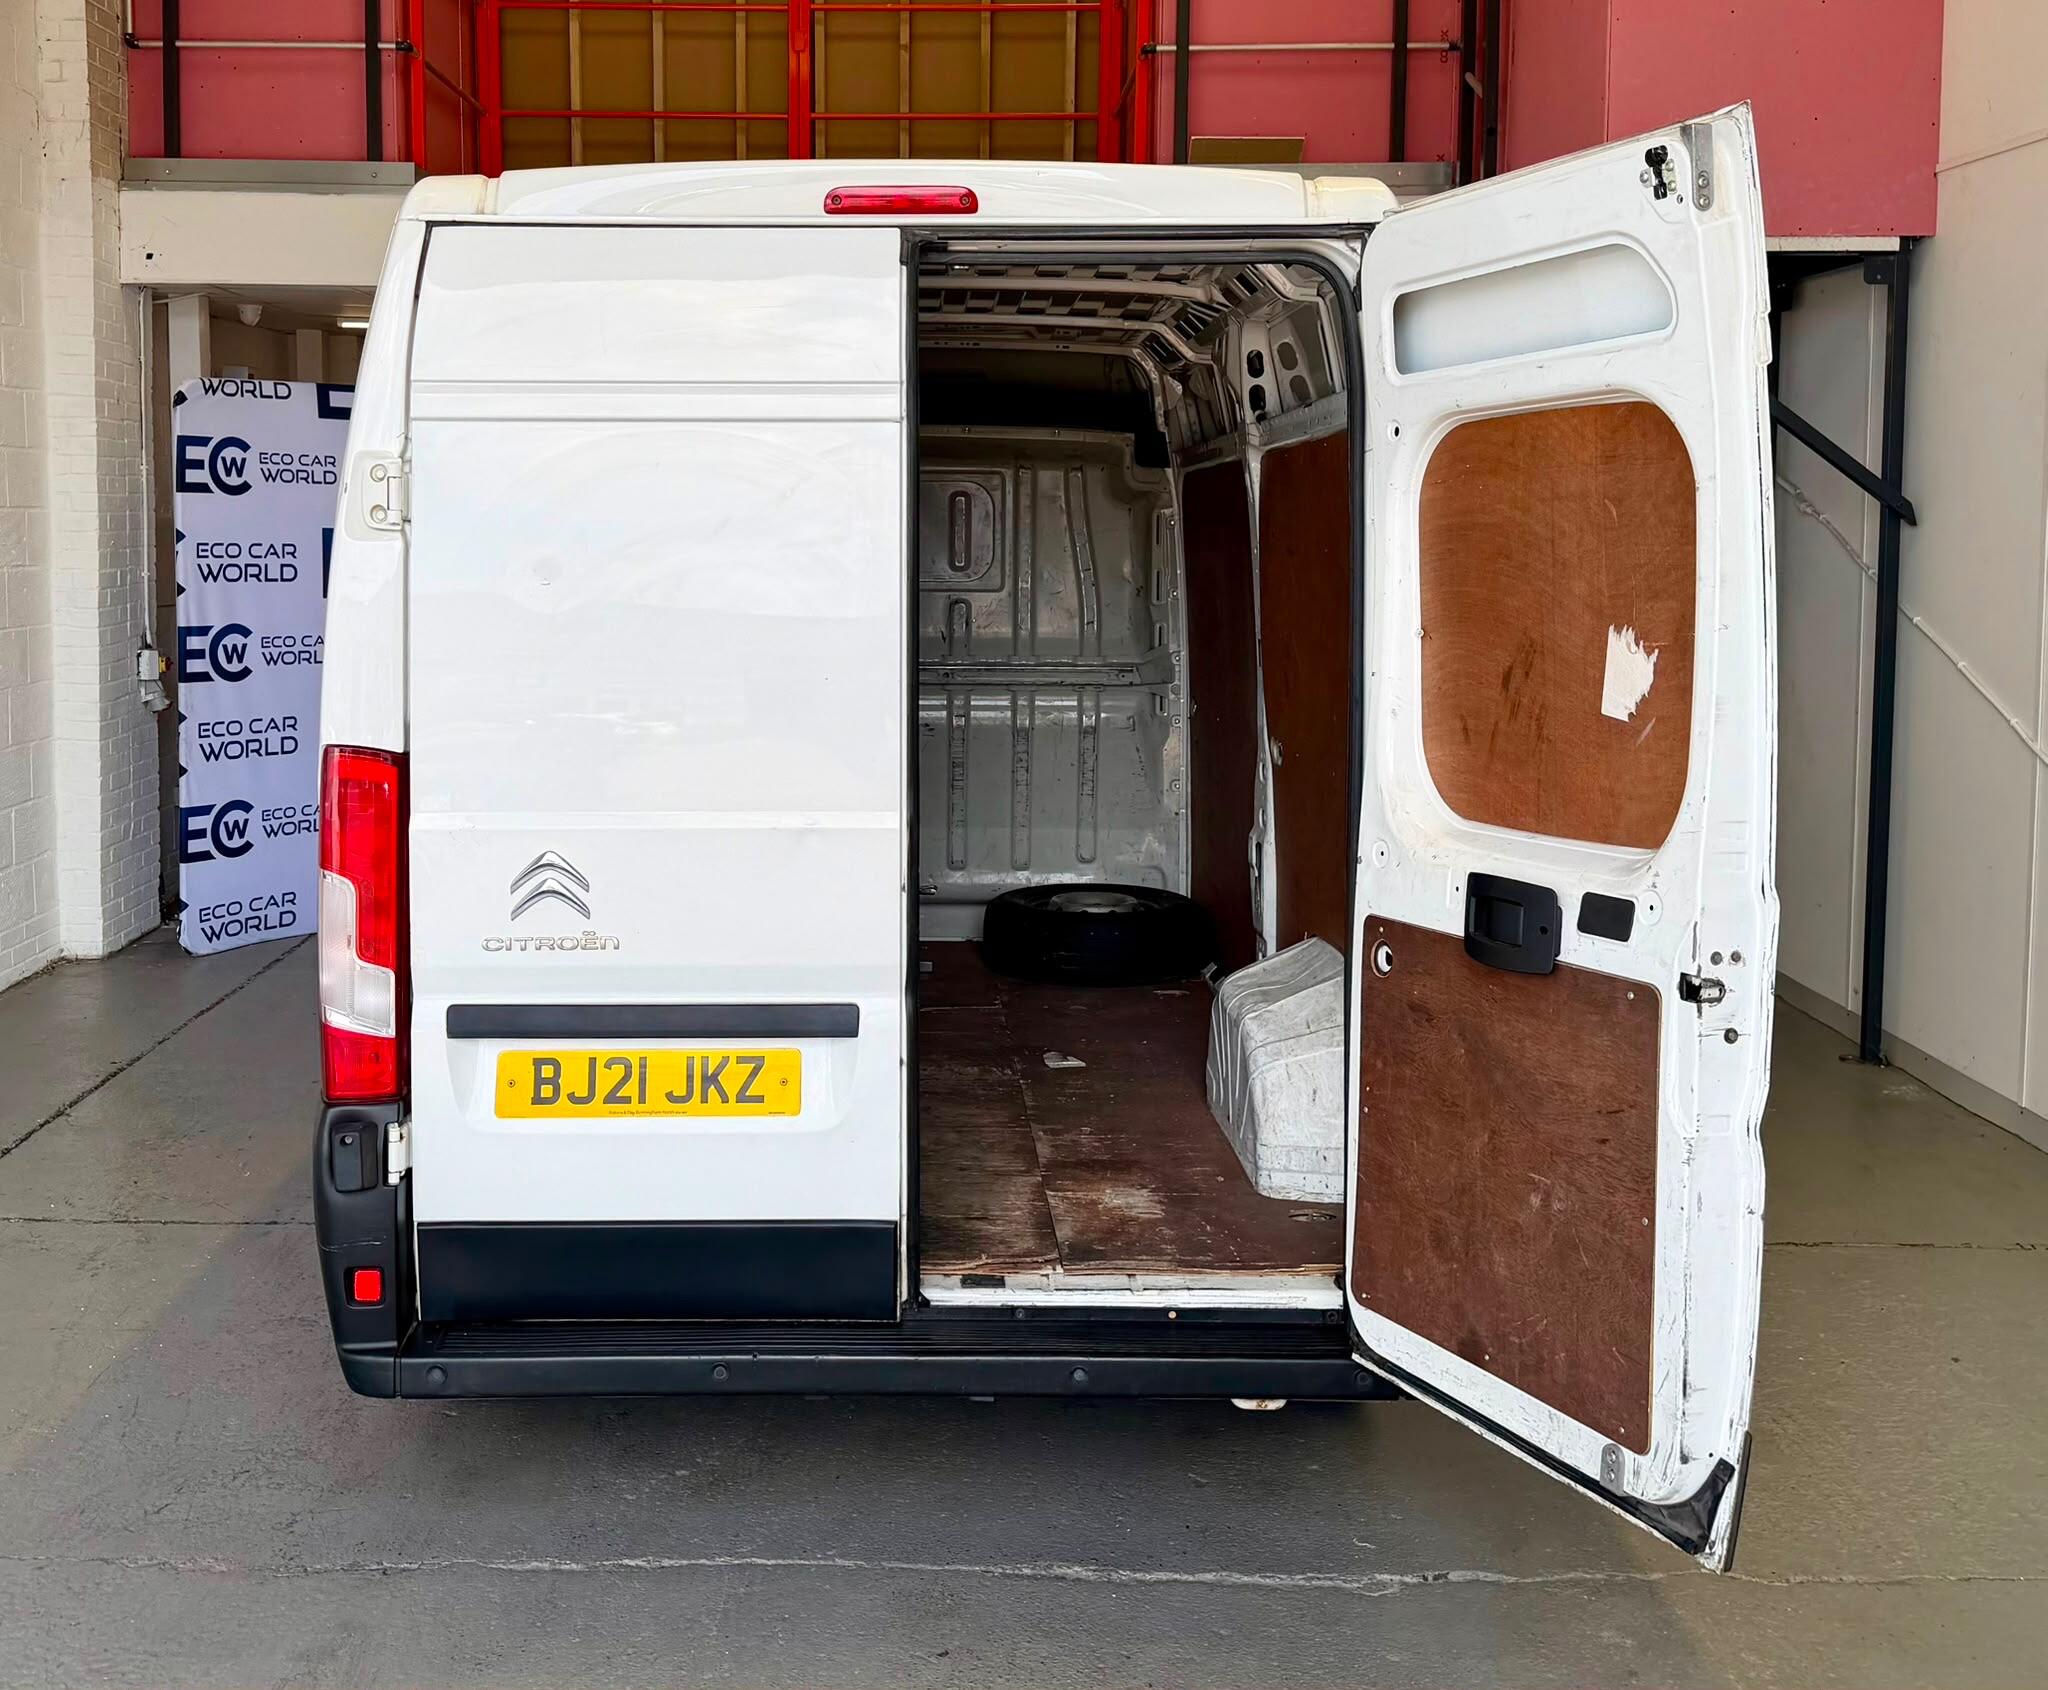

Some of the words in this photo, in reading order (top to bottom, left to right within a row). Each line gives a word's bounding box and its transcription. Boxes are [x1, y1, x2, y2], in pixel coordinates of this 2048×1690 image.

[200, 377, 292, 400] WORLD
[259, 452, 294, 465] ECO
[298, 454, 337, 467] CAR
[260, 467, 338, 485] WORLD
[196, 542, 242, 559] ECO
[248, 543, 298, 559] CAR
[197, 563, 298, 583] WORLD
[261, 636, 297, 648] ECO
[301, 635, 325, 647] CA
[261, 650, 324, 666] WORL
[198, 720, 243, 739] ECO
[249, 716, 298, 735] CAR
[199, 736, 299, 763] WORLD
[262, 806, 297, 822] ECO
[262, 818, 320, 839] WORL
[199, 901, 243, 923] ECO
[249, 891, 297, 914] CAR
[200, 909, 297, 944] WORLD
[531, 1057, 648, 1106] BJ21
[664, 1055, 765, 1105] JKZ
